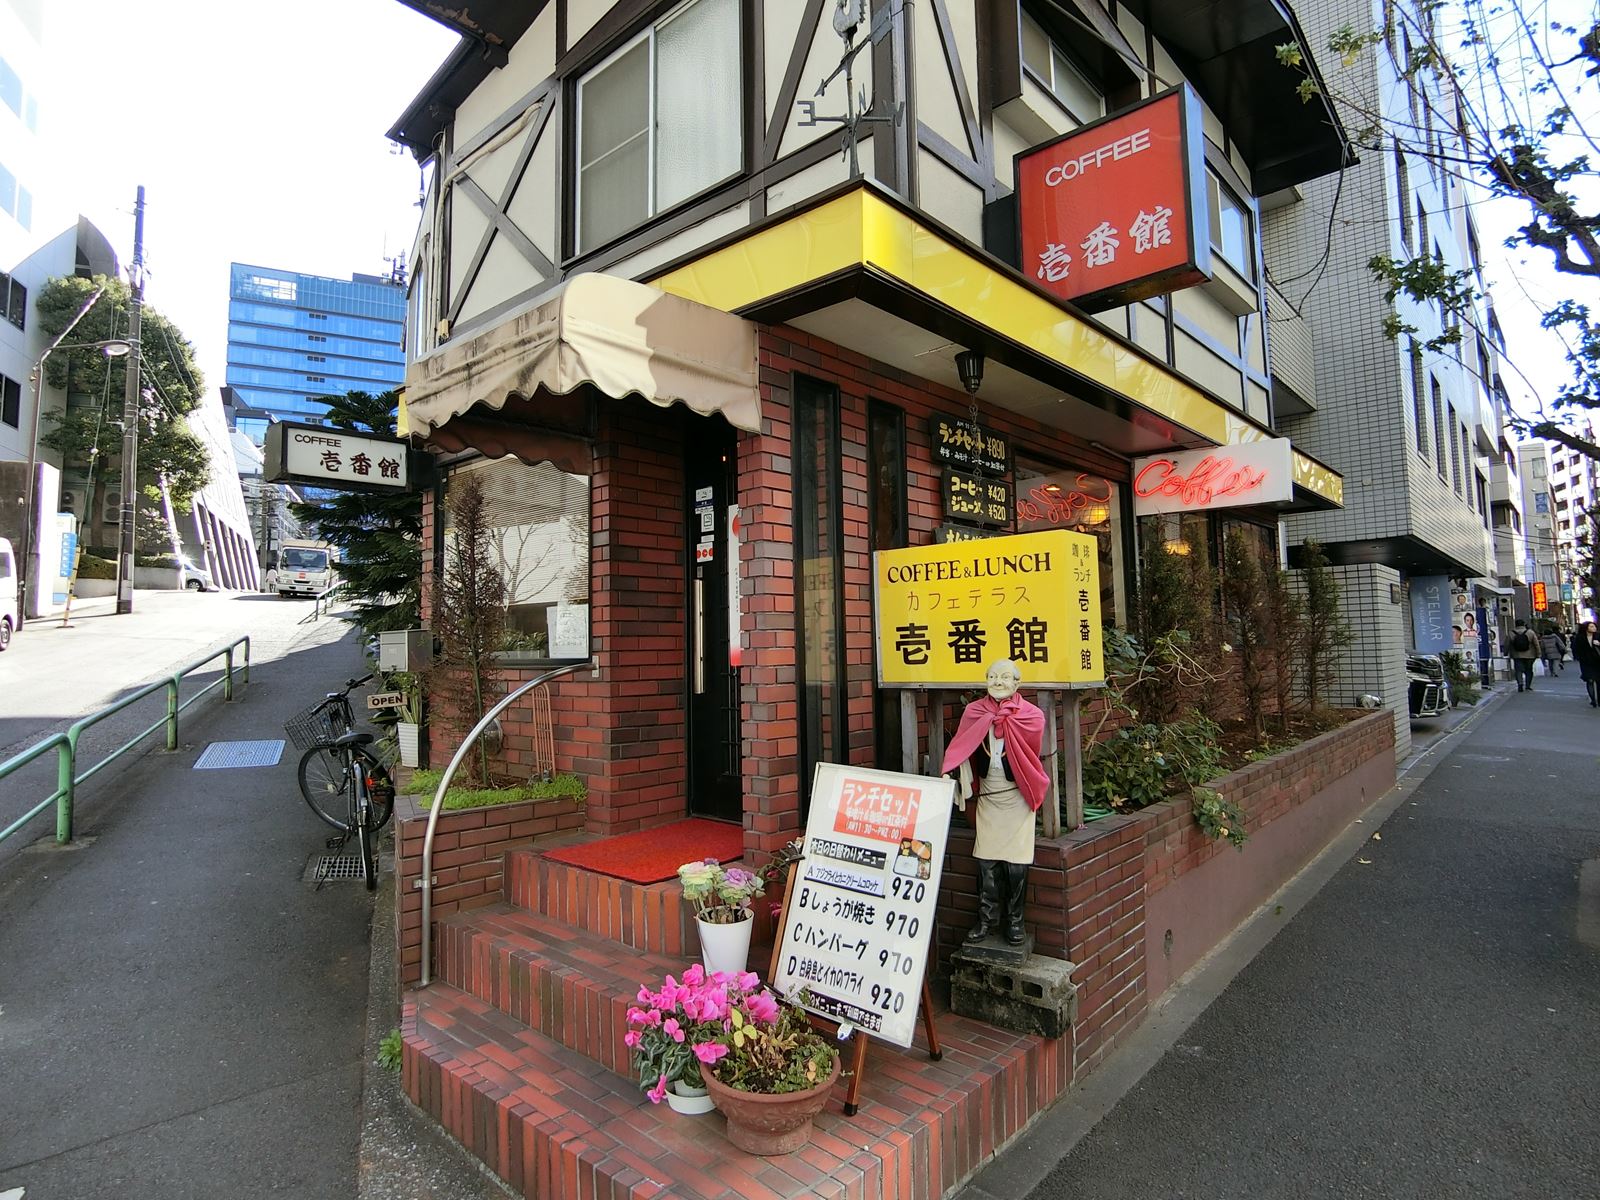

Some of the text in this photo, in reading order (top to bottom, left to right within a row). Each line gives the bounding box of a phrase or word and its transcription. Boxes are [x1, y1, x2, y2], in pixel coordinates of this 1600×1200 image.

[1045, 128, 1151, 187] COFFEE
[1037, 206, 1173, 282] 壱番館
[294, 433, 342, 448] COFFEE
[986, 436, 1005, 460] ¥890
[319, 449, 400, 479] 壱番館
[987, 484, 1006, 503] ¥420
[1134, 455, 1267, 505] Coffee
[987, 503, 1006, 521] ¥520
[1072, 567, 1092, 583] ランチ
[907, 586, 1031, 611] カフェテラス
[895, 616, 1049, 665] 壱番館
[1078, 588, 1092, 671] 壱番館
[371, 695, 404, 706] OPEN
[842, 783, 919, 815] ランチセット
[811, 839, 886, 865] 本日の日替わりメニュー
[891, 876, 926, 904] 920
[800, 887, 920, 939] B しょうが焼き 970
[793, 922, 913, 976] C ハンバーグ 970
[787, 955, 905, 1014] D 白身魚とイカのフライ 920
